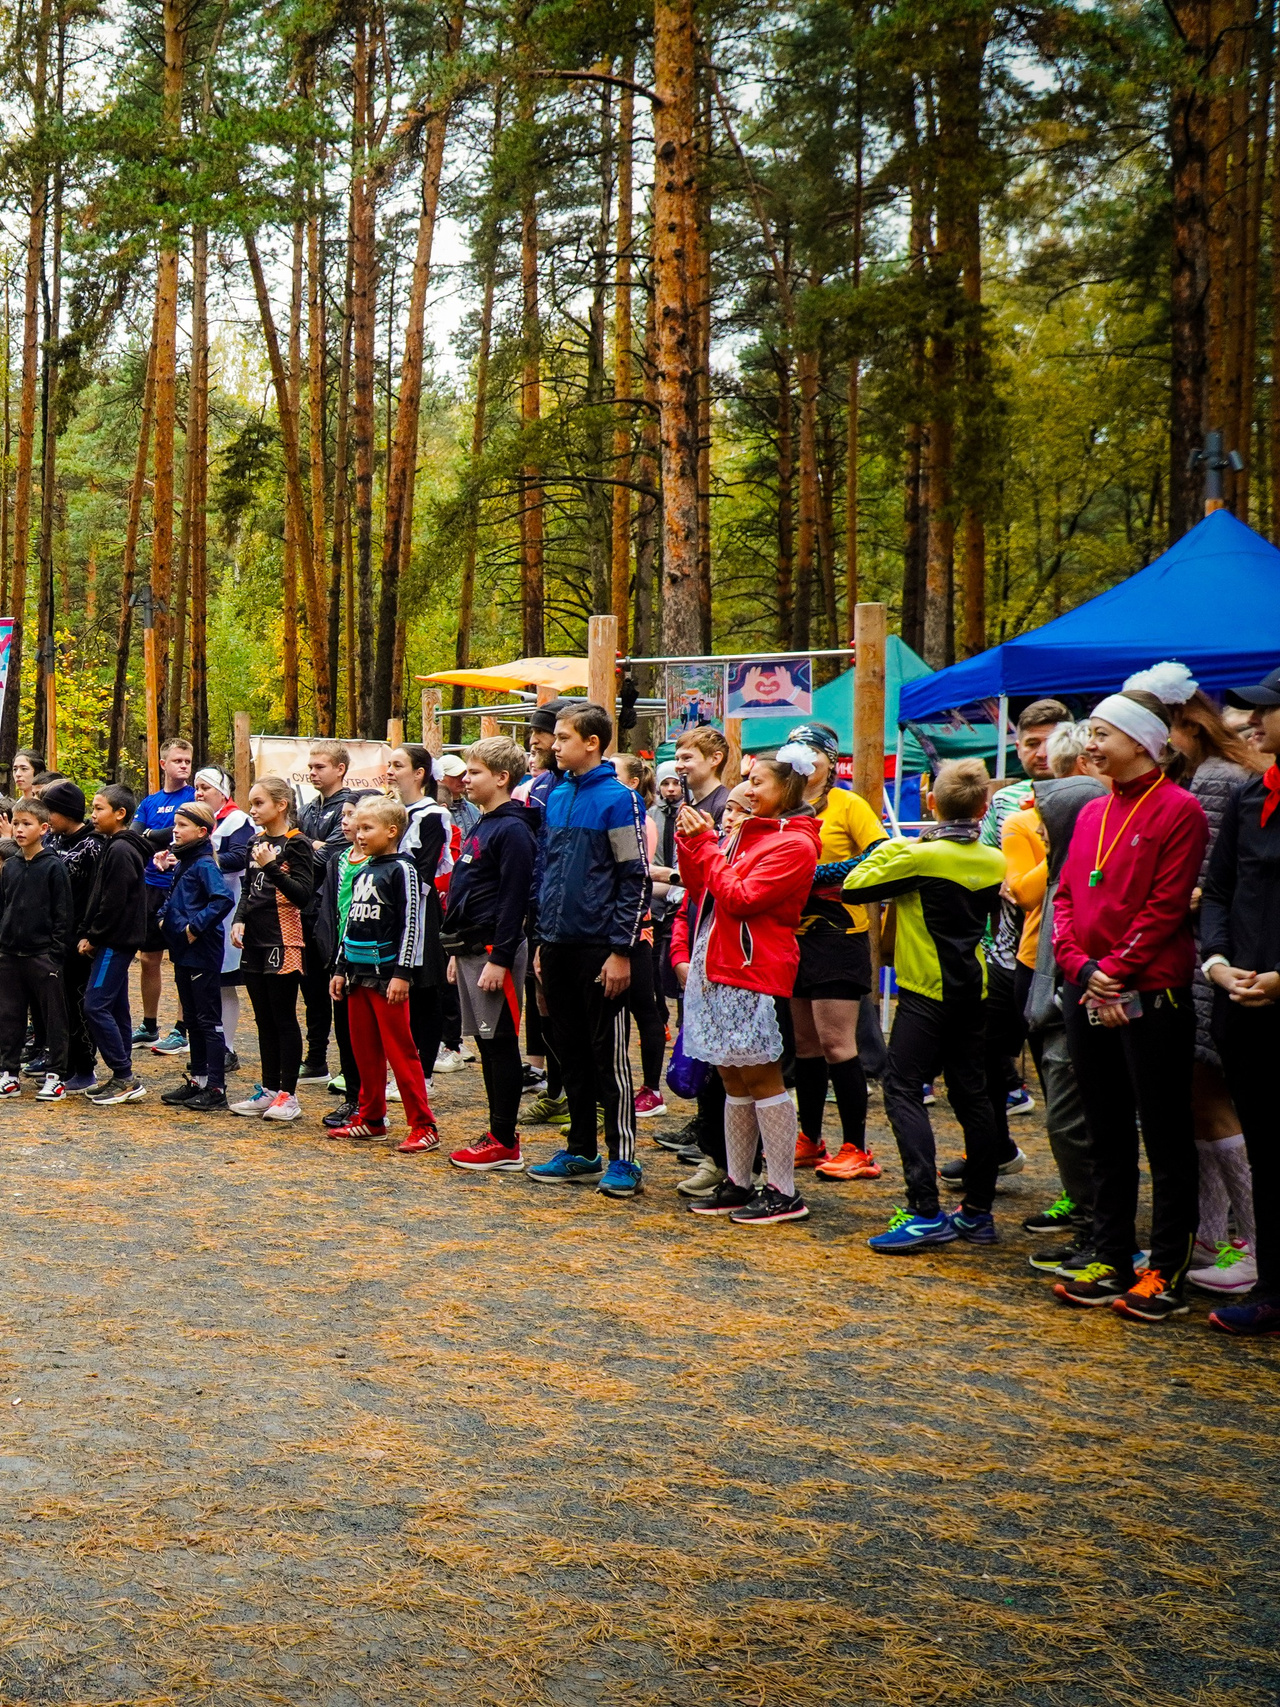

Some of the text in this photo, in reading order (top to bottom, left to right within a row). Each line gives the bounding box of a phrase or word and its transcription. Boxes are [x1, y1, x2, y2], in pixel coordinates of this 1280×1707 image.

[254, 871, 265, 891] 4
[349, 902, 381, 922] appa
[268, 946, 280, 968] 4
